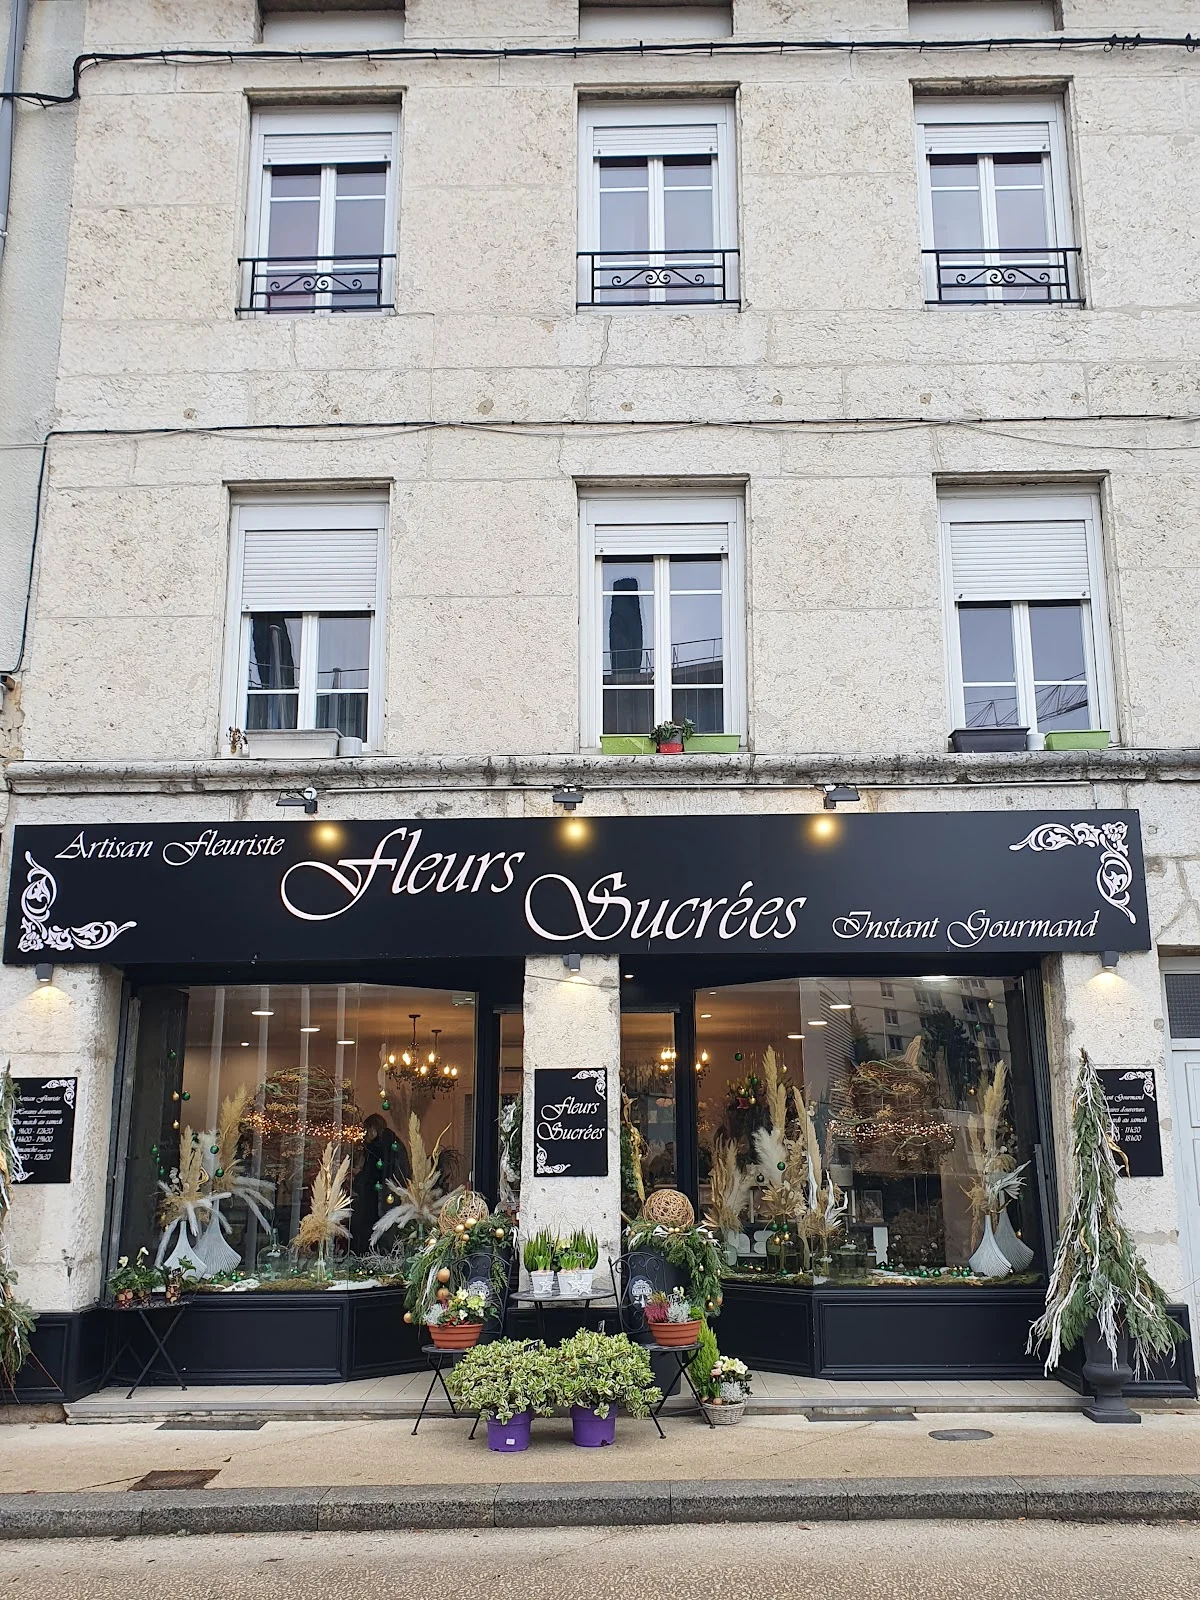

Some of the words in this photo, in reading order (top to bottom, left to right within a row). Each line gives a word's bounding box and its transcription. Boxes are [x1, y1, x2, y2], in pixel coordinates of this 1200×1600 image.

[55, 831, 154, 859] Artisan
[163, 829, 285, 867] Fleuriste
[281, 827, 526, 921] Fleurs
[525, 869, 808, 941] Sucrées
[832, 910, 940, 939] Instant
[946, 909, 1100, 949] Gourmand
[541, 1096, 600, 1120] Fleurs
[537, 1121, 605, 1140] Sucrées
